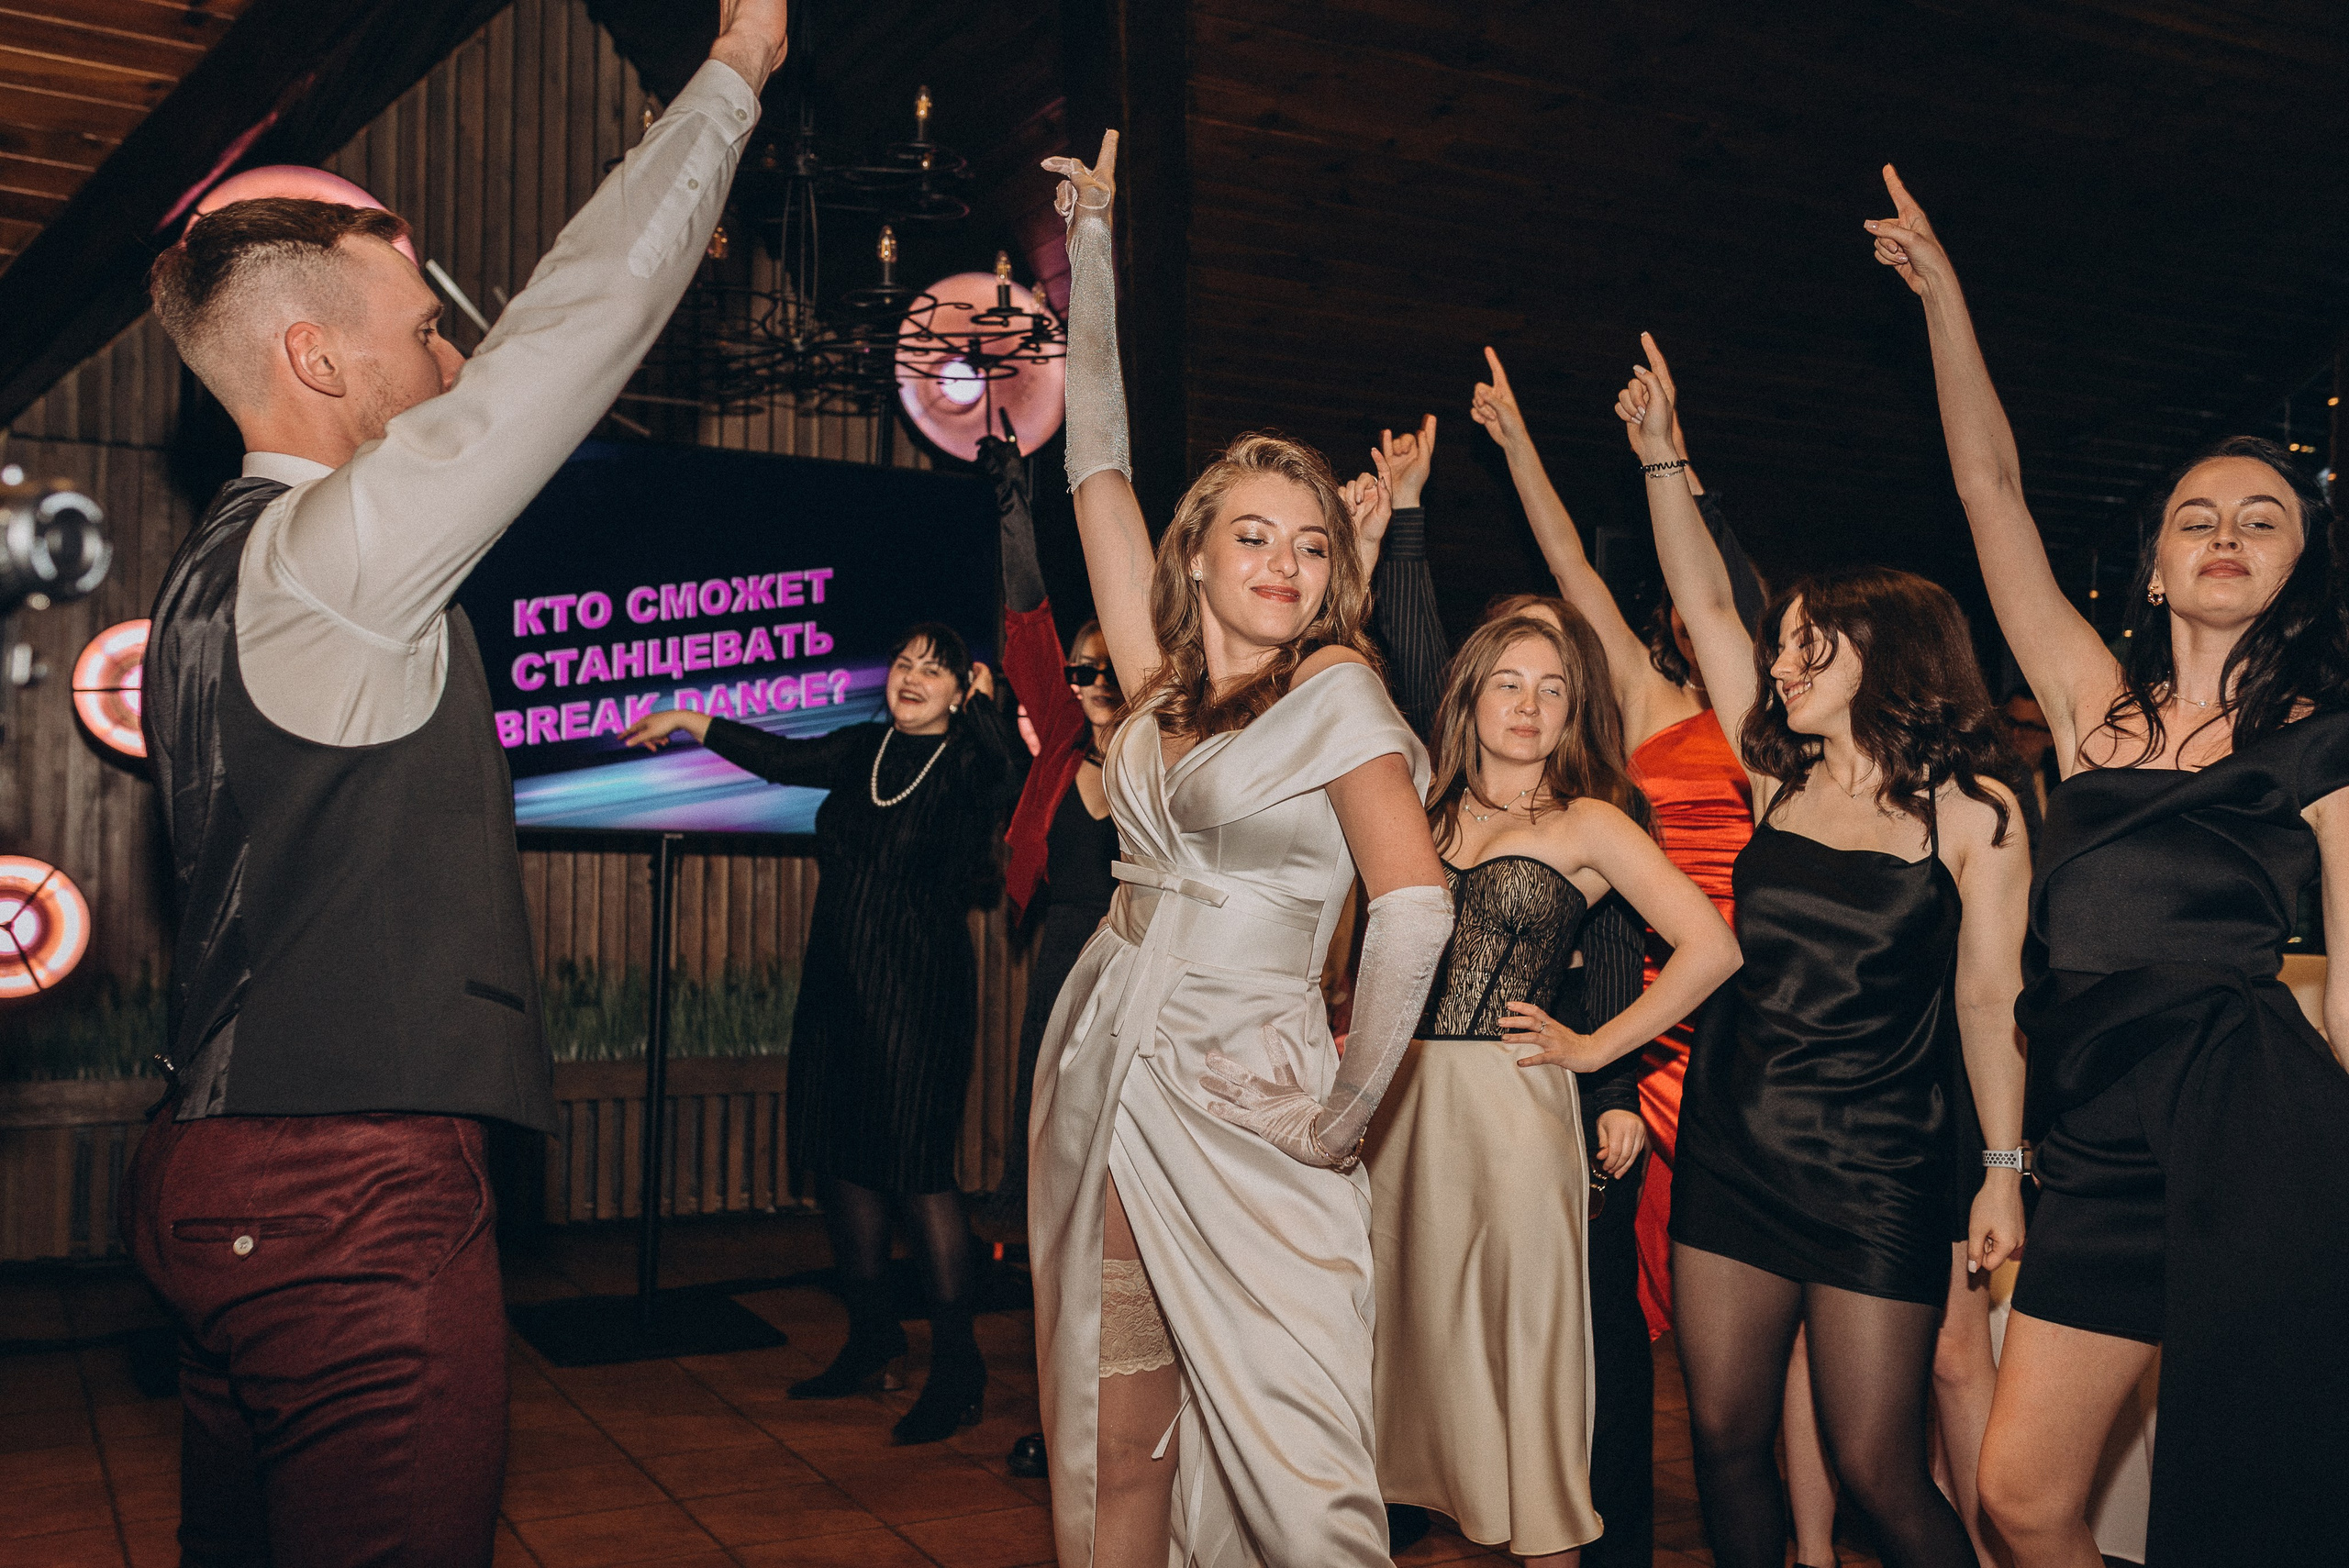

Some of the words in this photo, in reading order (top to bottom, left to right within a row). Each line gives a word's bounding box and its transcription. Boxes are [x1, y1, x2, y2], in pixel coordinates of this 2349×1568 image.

[513, 591, 613, 638] КТО
[626, 568, 834, 624] СМОЖЕТ
[511, 621, 835, 691] СТАНЦЕВАТЬ
[495, 693, 660, 749] BREAK
[674, 669, 852, 718] DANCE?
